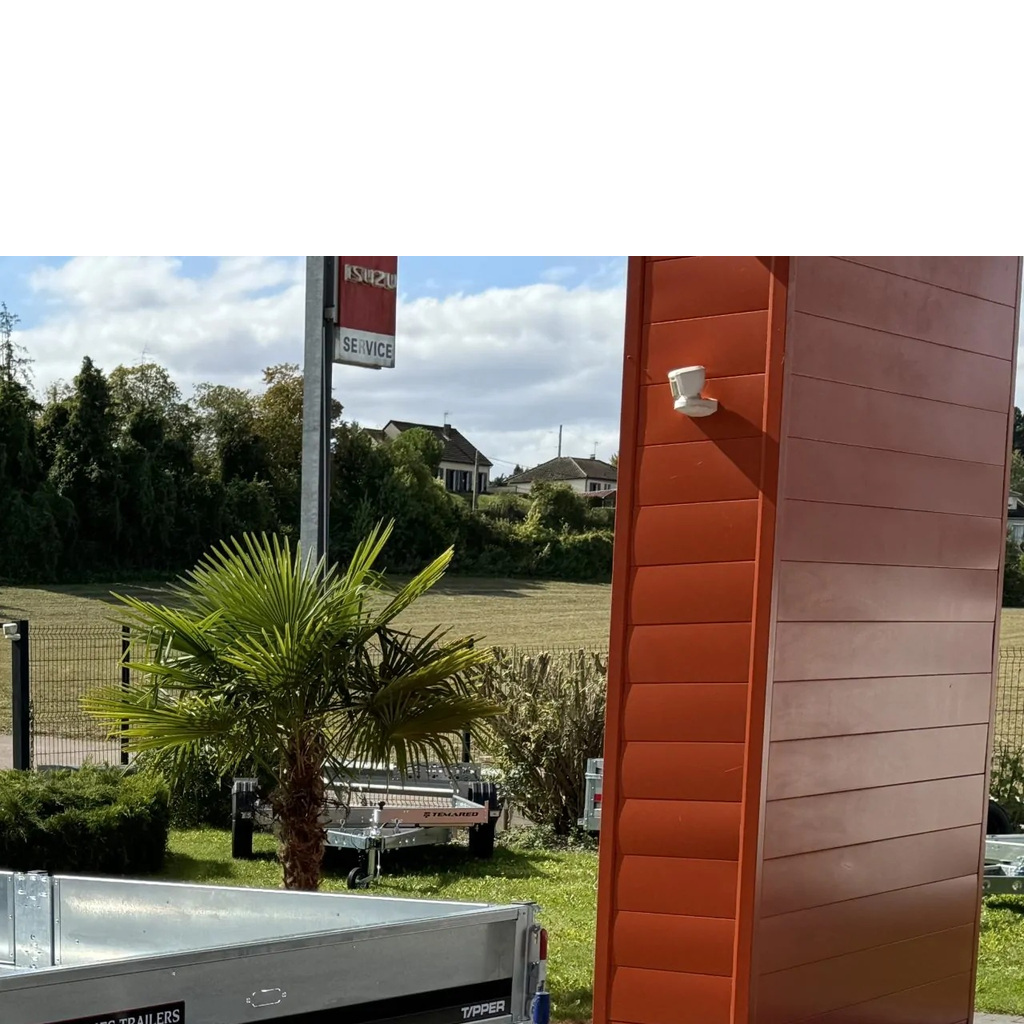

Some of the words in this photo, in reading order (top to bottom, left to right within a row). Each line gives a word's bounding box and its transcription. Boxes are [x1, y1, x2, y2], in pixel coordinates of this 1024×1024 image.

[344, 264, 396, 290] ISUZU
[343, 336, 393, 359] SERVICE
[461, 1000, 505, 1019] TIPPER
